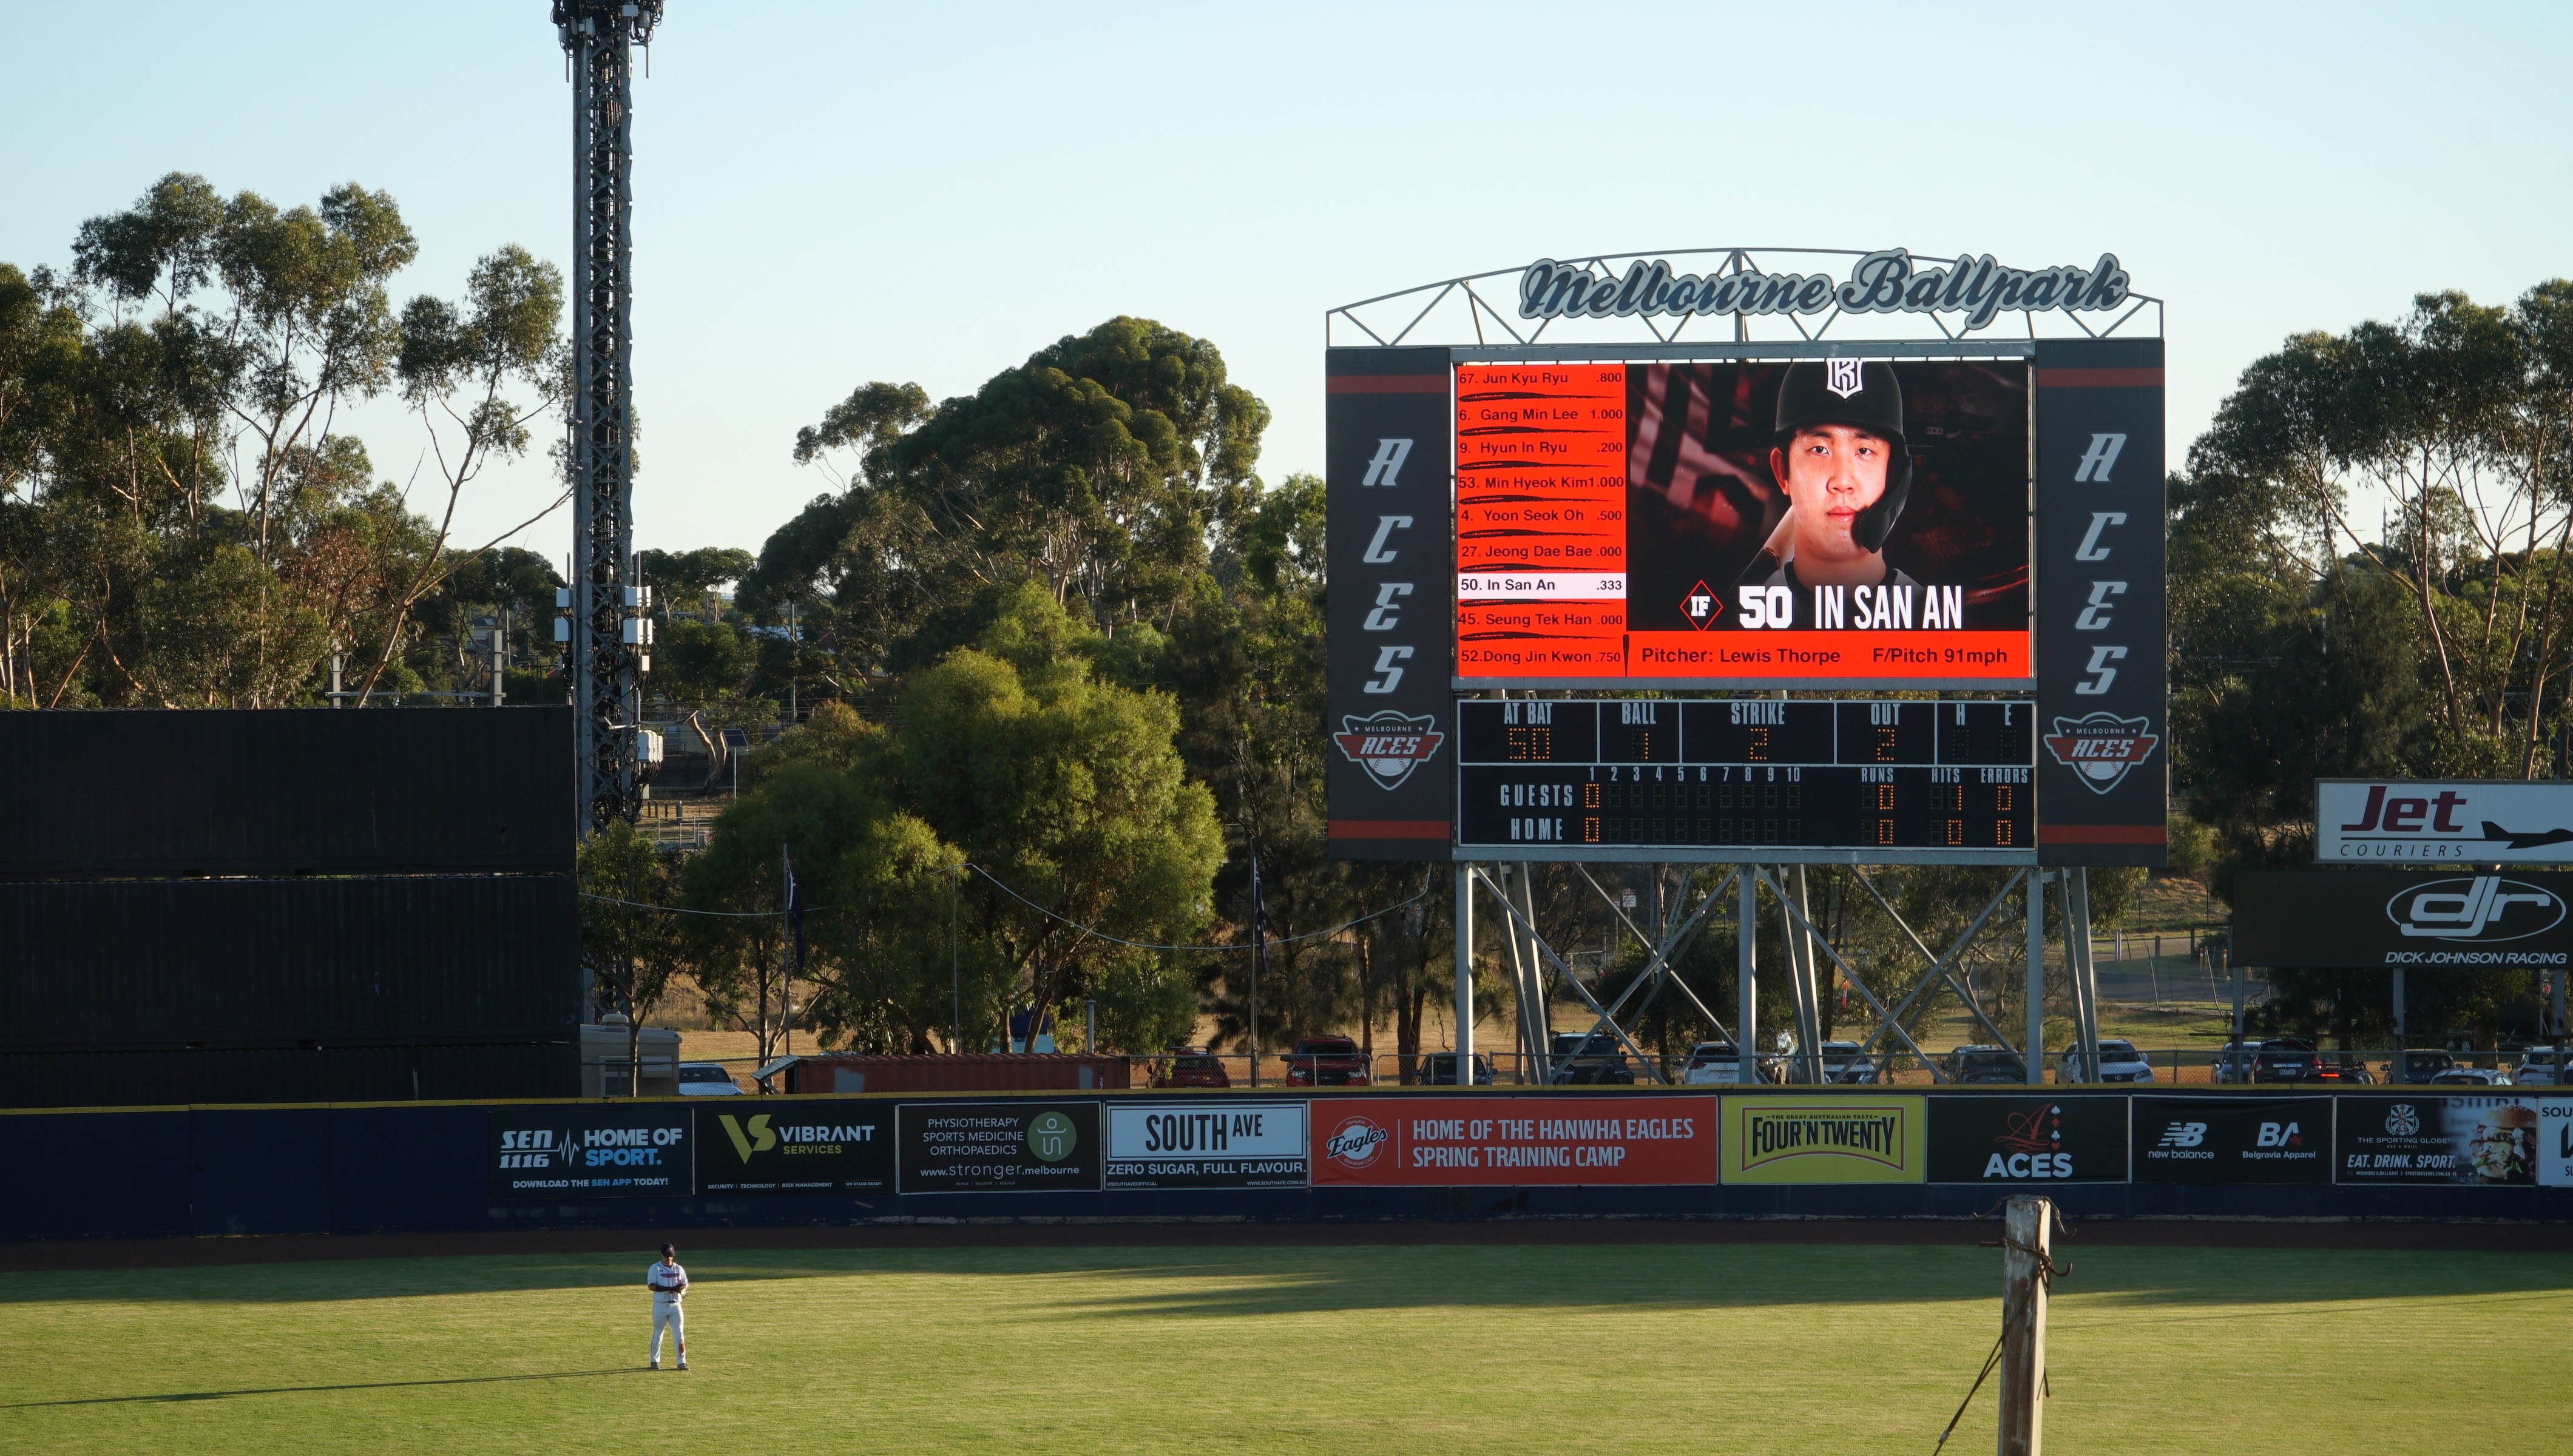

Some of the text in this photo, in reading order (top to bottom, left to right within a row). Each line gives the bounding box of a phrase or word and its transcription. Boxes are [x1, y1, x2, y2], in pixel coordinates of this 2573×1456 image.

[1522, 248, 2130, 329] Melbourne Ballpark
[1459, 372, 1621, 385] 67. Jun Kyu Ryu .800
[1459, 409, 1623, 422] 6. Gang Min Lee 1.000
[1460, 442, 1622, 456] 9. Hyun In Ryu .200
[1458, 477, 1479, 488] 53.
[1486, 478, 1509, 488] Min
[1514, 477, 1556, 490] Hyeok
[1461, 510, 1621, 521] 4. Yoon Seok Oh .500
[1462, 546, 1621, 559] 27. Jeong Dae Bae .000
[1461, 579, 1621, 590] 50. In San An .333
[1691, 596, 1710, 616] IF
[1739, 586, 1793, 629] 50
[1815, 585, 1962, 629] IN SAN AN
[1458, 614, 1622, 627] 45. Seung Tek Han .000
[1526, 651, 1546, 662] Jin
[1552, 651, 1591, 662] Kwon
[1596, 653, 1620, 662] .750
[1643, 649, 1841, 666] Pitcher: Lewis Thorpe
[1873, 649, 2007, 666] F/Pitch 91mph
[1504, 703, 1552, 724] AT BAT
[1622, 703, 1655, 724] BALL
[1731, 703, 1785, 725] STRIKE
[1871, 704, 1900, 725] OUT
[1956, 704, 1966, 726] H
[2006, 704, 2012, 726] E
[1360, 737, 1421, 755] ACES
[1509, 727, 1549, 760] 50
[1750, 727, 1767, 760] 2
[1877, 729, 1895, 761] 2
[2071, 740, 2134, 758] ACES
[1590, 767, 1800, 781] 1 2 3 4 5 6 7 8 9 10
[1862, 768, 1893, 783] RUNS
[1932, 768, 1960, 783] HITS
[1981, 769, 2027, 783] ERRORS
[1500, 784, 1573, 807] GUESTS
[2341, 786, 2467, 832] Jet
[1511, 818, 1563, 840] HOME
[2341, 844, 2463, 857] COURIERS
[2385, 952, 2567, 965] DICK JOHNSON RACING
[928, 1118, 1019, 1128] PHYSIOTHERAPY
[1413, 1118, 1694, 1140] HOME OF THE HANWHA EAGLES
[501, 1130, 552, 1148] SEN
[584, 1128, 682, 1147] HOME OF
[779, 1125, 874, 1142] VIBRANT
[923, 1131, 1024, 1142] SPORTS MEDICINE
[1146, 1114, 1263, 1151] SOUTH AVE
[1821, 1116, 1895, 1156] TWENTY
[783, 1145, 842, 1154] SERVICES
[930, 1145, 1017, 1156] ORTHOPAEDICS
[1327, 1125, 1387, 1159] Eagles
[499, 1154, 549, 1168] 1116
[585, 1148, 661, 1166] SPORT.
[1413, 1147, 1625, 1168] SPRING TRAINING CAMP
[2148, 1150, 2214, 1159] new balance
[2243, 1151, 2316, 1159] Belgravia Apparel
[2347, 1155, 2456, 1168] EAT. DRINK. SPORT.
[921, 1163, 1080, 1179] www.stronger.melbourne
[1107, 1162, 1307, 1176] ZERO SUGAR, FULL FLAVOUR.
[1983, 1153, 2072, 1178] ACES
